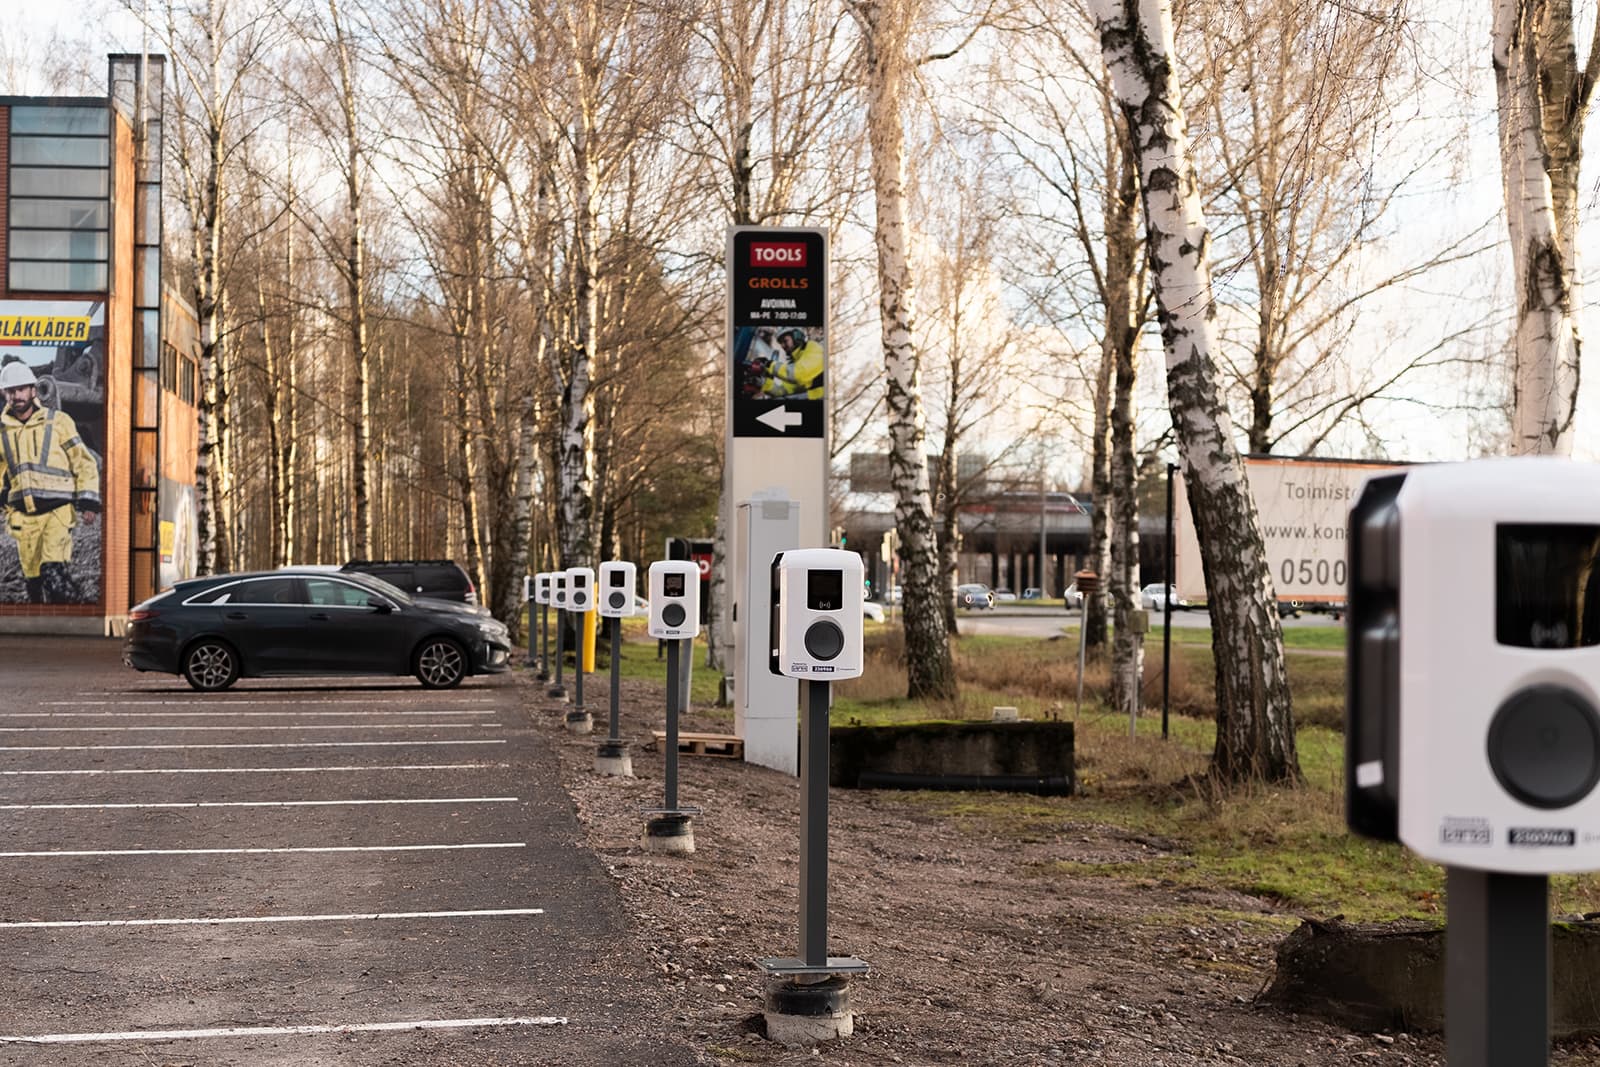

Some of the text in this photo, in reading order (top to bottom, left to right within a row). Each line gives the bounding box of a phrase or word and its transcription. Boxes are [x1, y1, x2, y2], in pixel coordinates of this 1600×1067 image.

[754, 247, 802, 261] TOOLS
[748, 278, 808, 288] GROLLS
[0, 316, 86, 338] LÅKLÄDER
[1281, 558, 1347, 586] 0500
